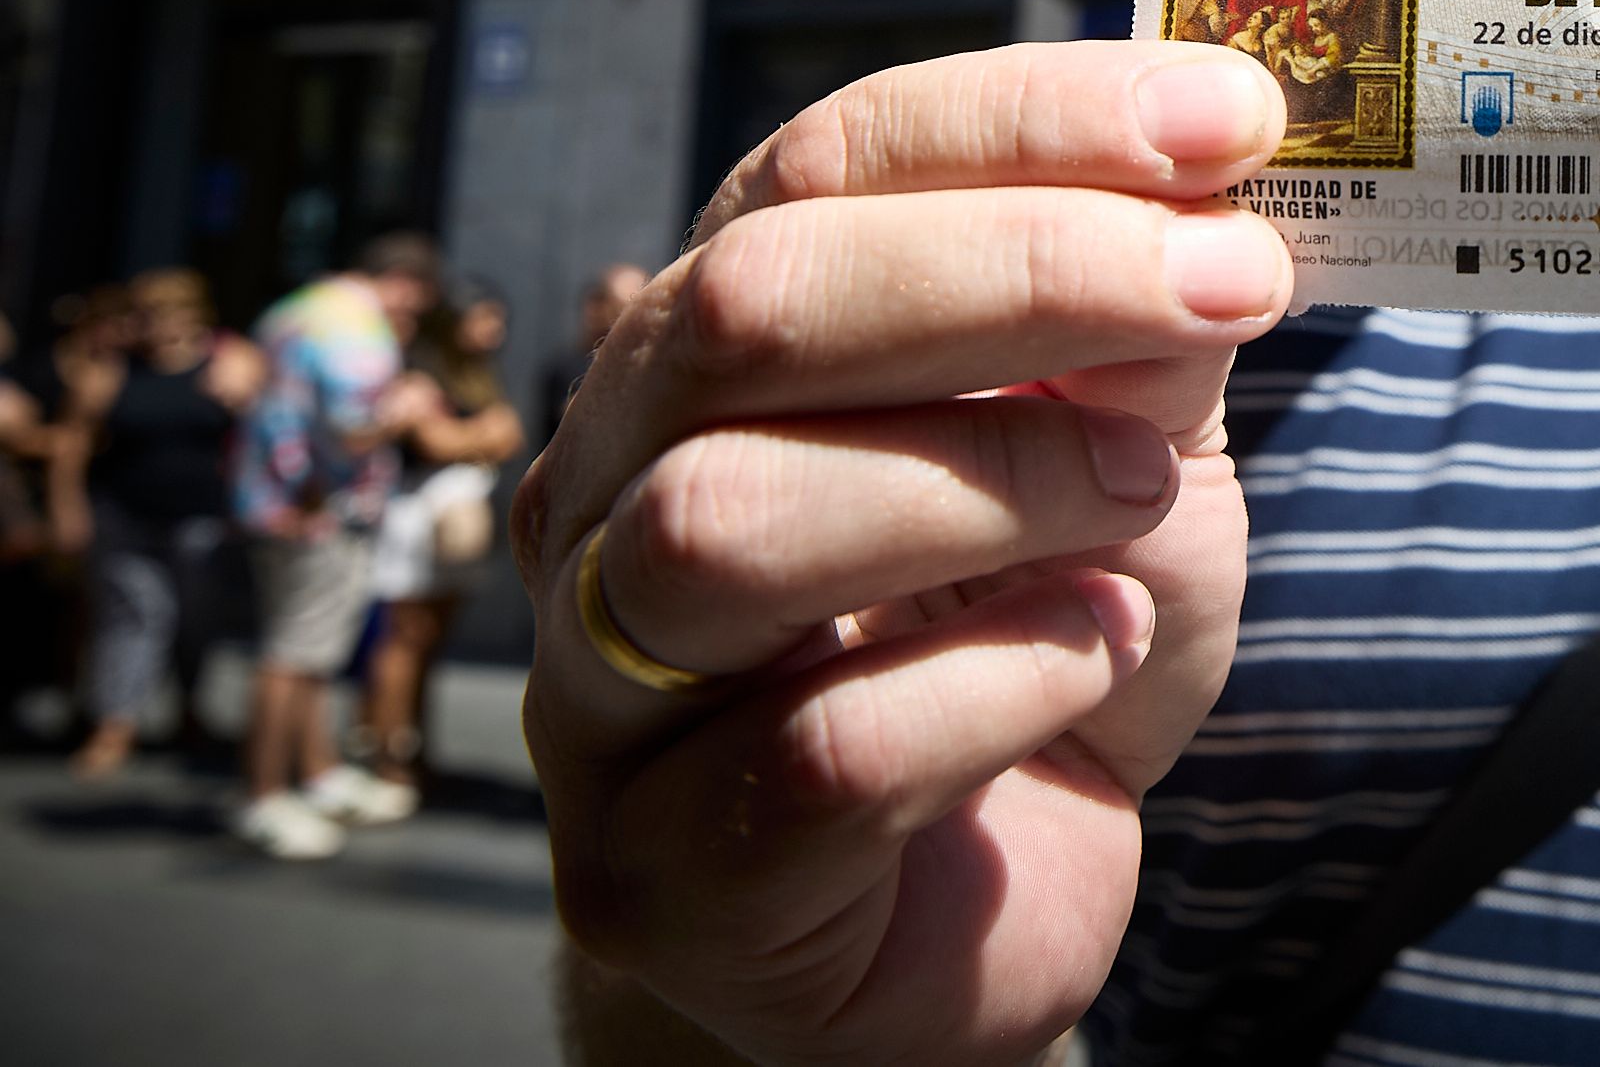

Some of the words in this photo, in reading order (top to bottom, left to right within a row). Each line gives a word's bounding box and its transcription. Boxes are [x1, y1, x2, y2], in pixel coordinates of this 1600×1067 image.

[1473, 22, 1506, 46] 22
[1517, 21, 1552, 46] de
[1351, 180, 1377, 199] DE
[1295, 231, 1331, 245] Juan
[1321, 254, 1371, 267] Nacional
